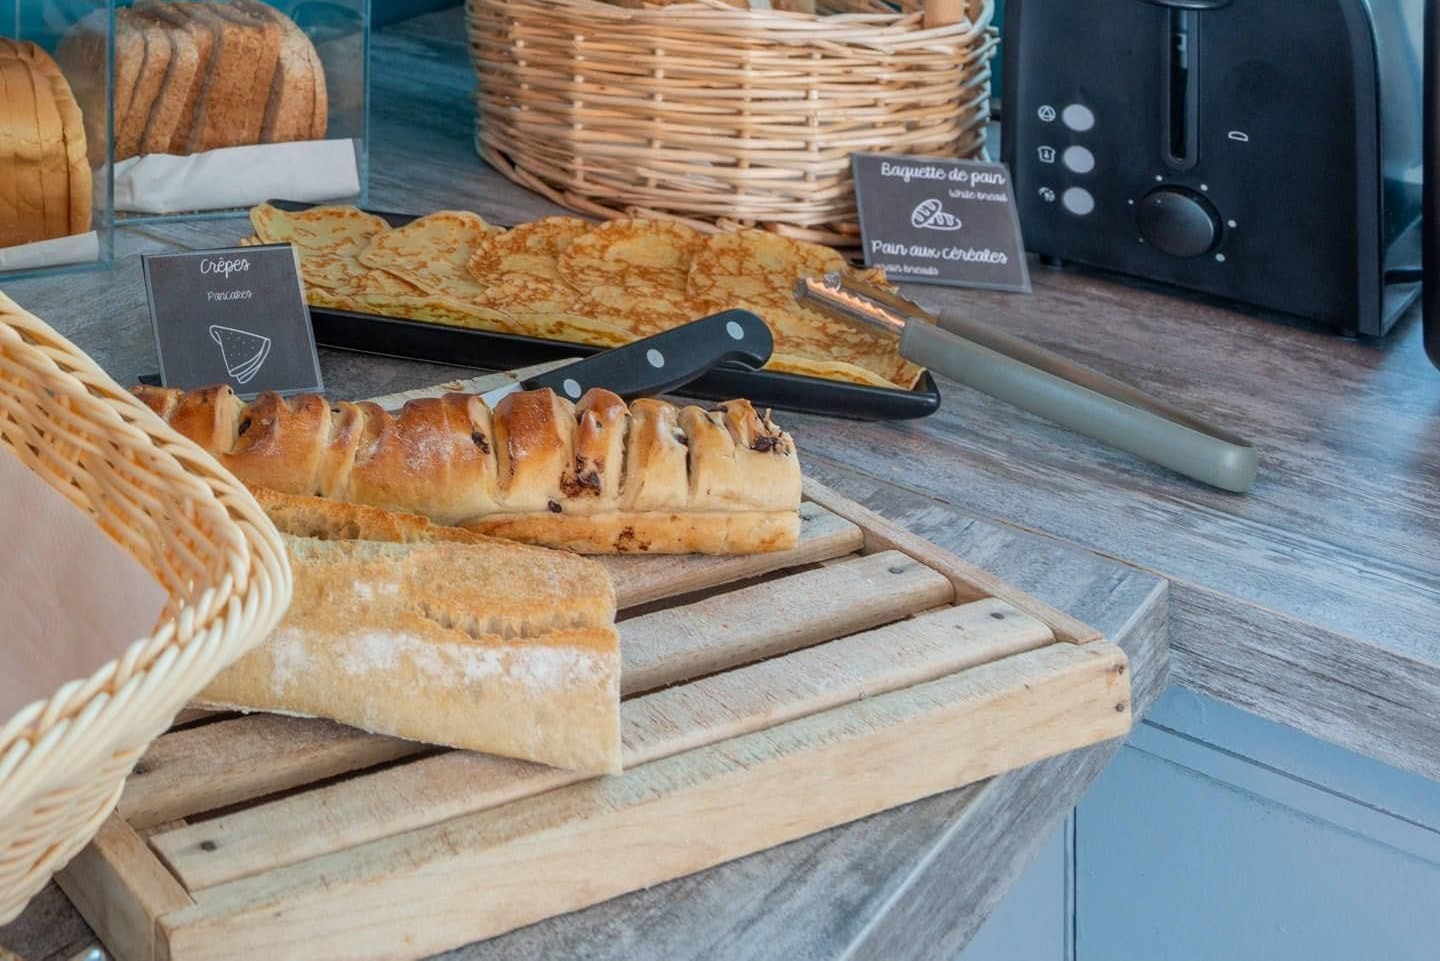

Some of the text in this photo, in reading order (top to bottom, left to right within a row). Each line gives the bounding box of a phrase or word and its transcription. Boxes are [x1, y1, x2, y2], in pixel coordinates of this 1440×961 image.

[881, 162, 1006, 188] Baguette de pain
[871, 240, 1008, 265] Pain aux céréales
[200, 256, 251, 279] Crêpes
[207, 289, 253, 302] Pancakes
